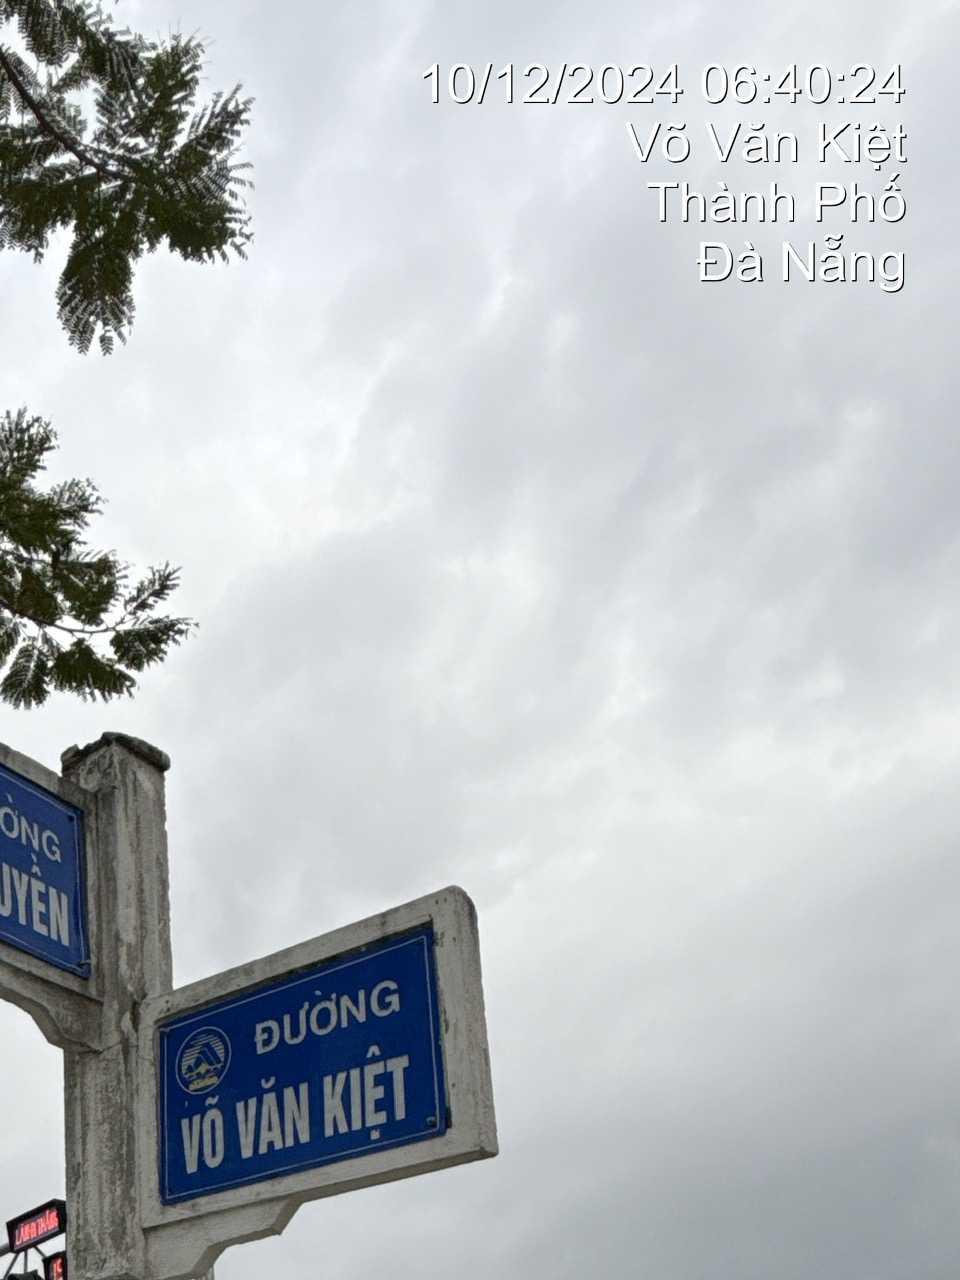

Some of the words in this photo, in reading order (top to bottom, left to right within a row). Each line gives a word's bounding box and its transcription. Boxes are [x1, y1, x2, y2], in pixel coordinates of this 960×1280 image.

[254, 980, 401, 1055] ĐƯỜNG
[181, 1095, 225, 1174] VÕ
[235, 1076, 310, 1159] VĂN
[323, 1045, 409, 1140] KIỆT
